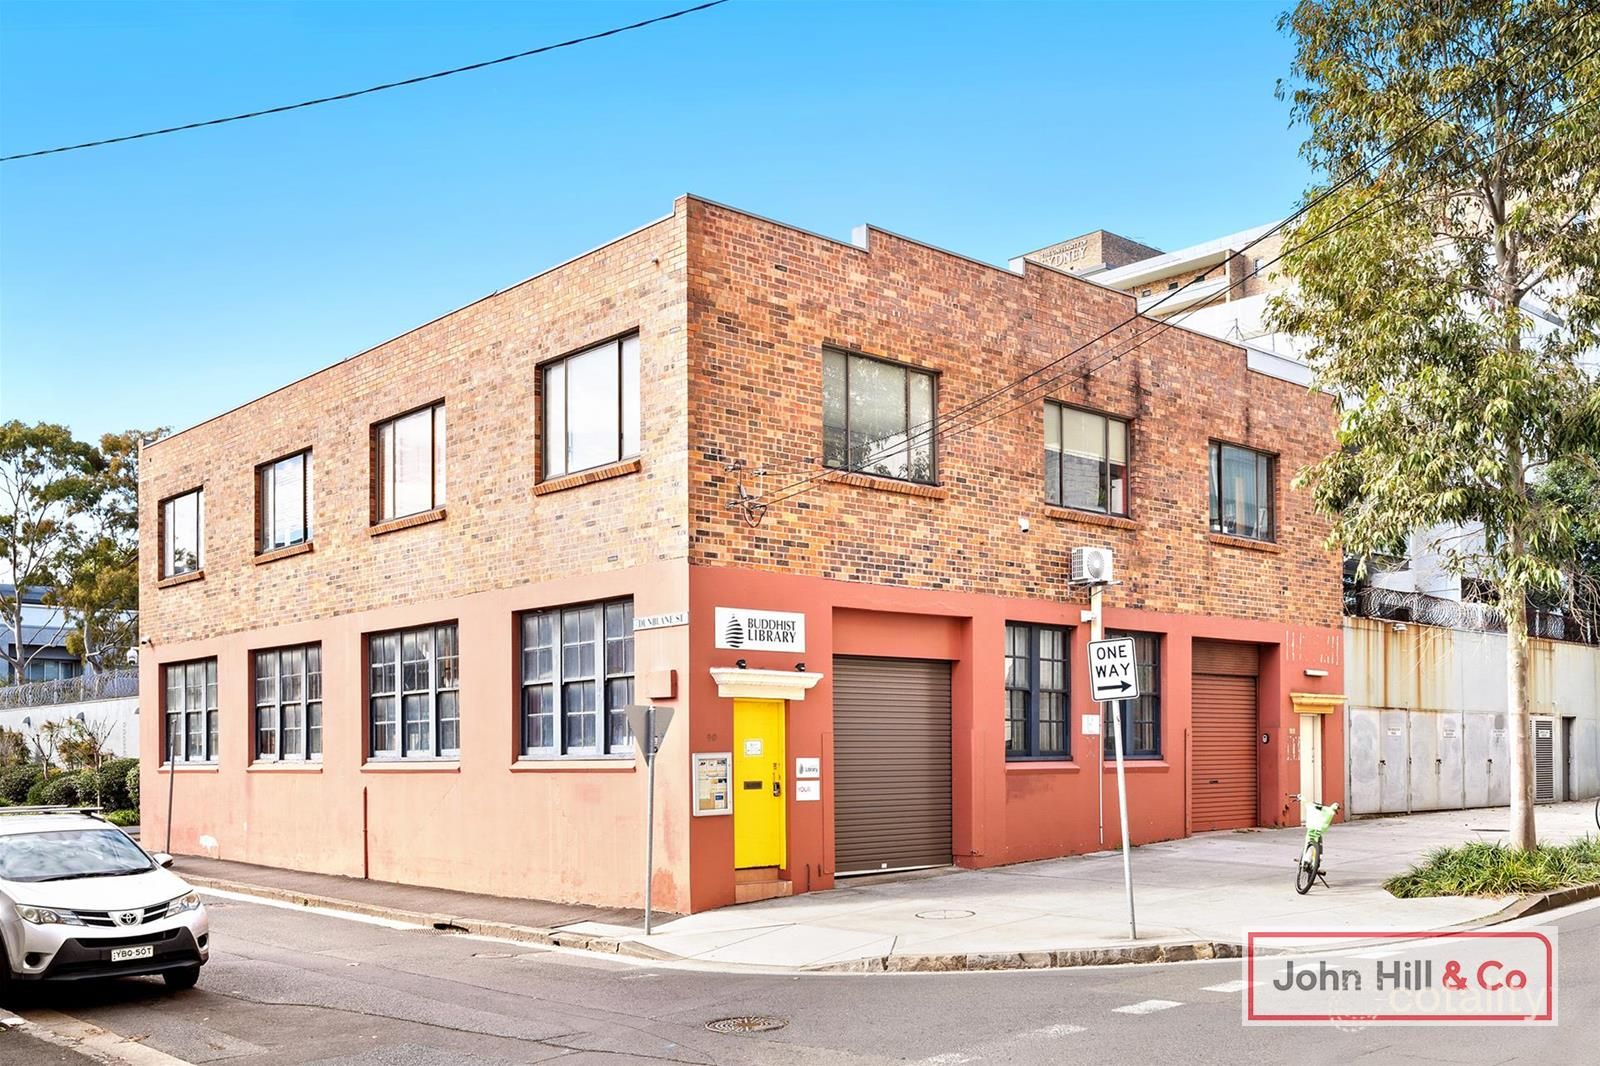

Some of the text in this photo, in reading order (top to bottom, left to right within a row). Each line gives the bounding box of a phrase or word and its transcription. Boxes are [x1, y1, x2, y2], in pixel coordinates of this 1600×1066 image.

[747, 618, 797, 632] BUDDHIST
[748, 629, 797, 643] LIBRARY
[1096, 644, 1127, 660] ONE
[1095, 662, 1130, 678] WAY
